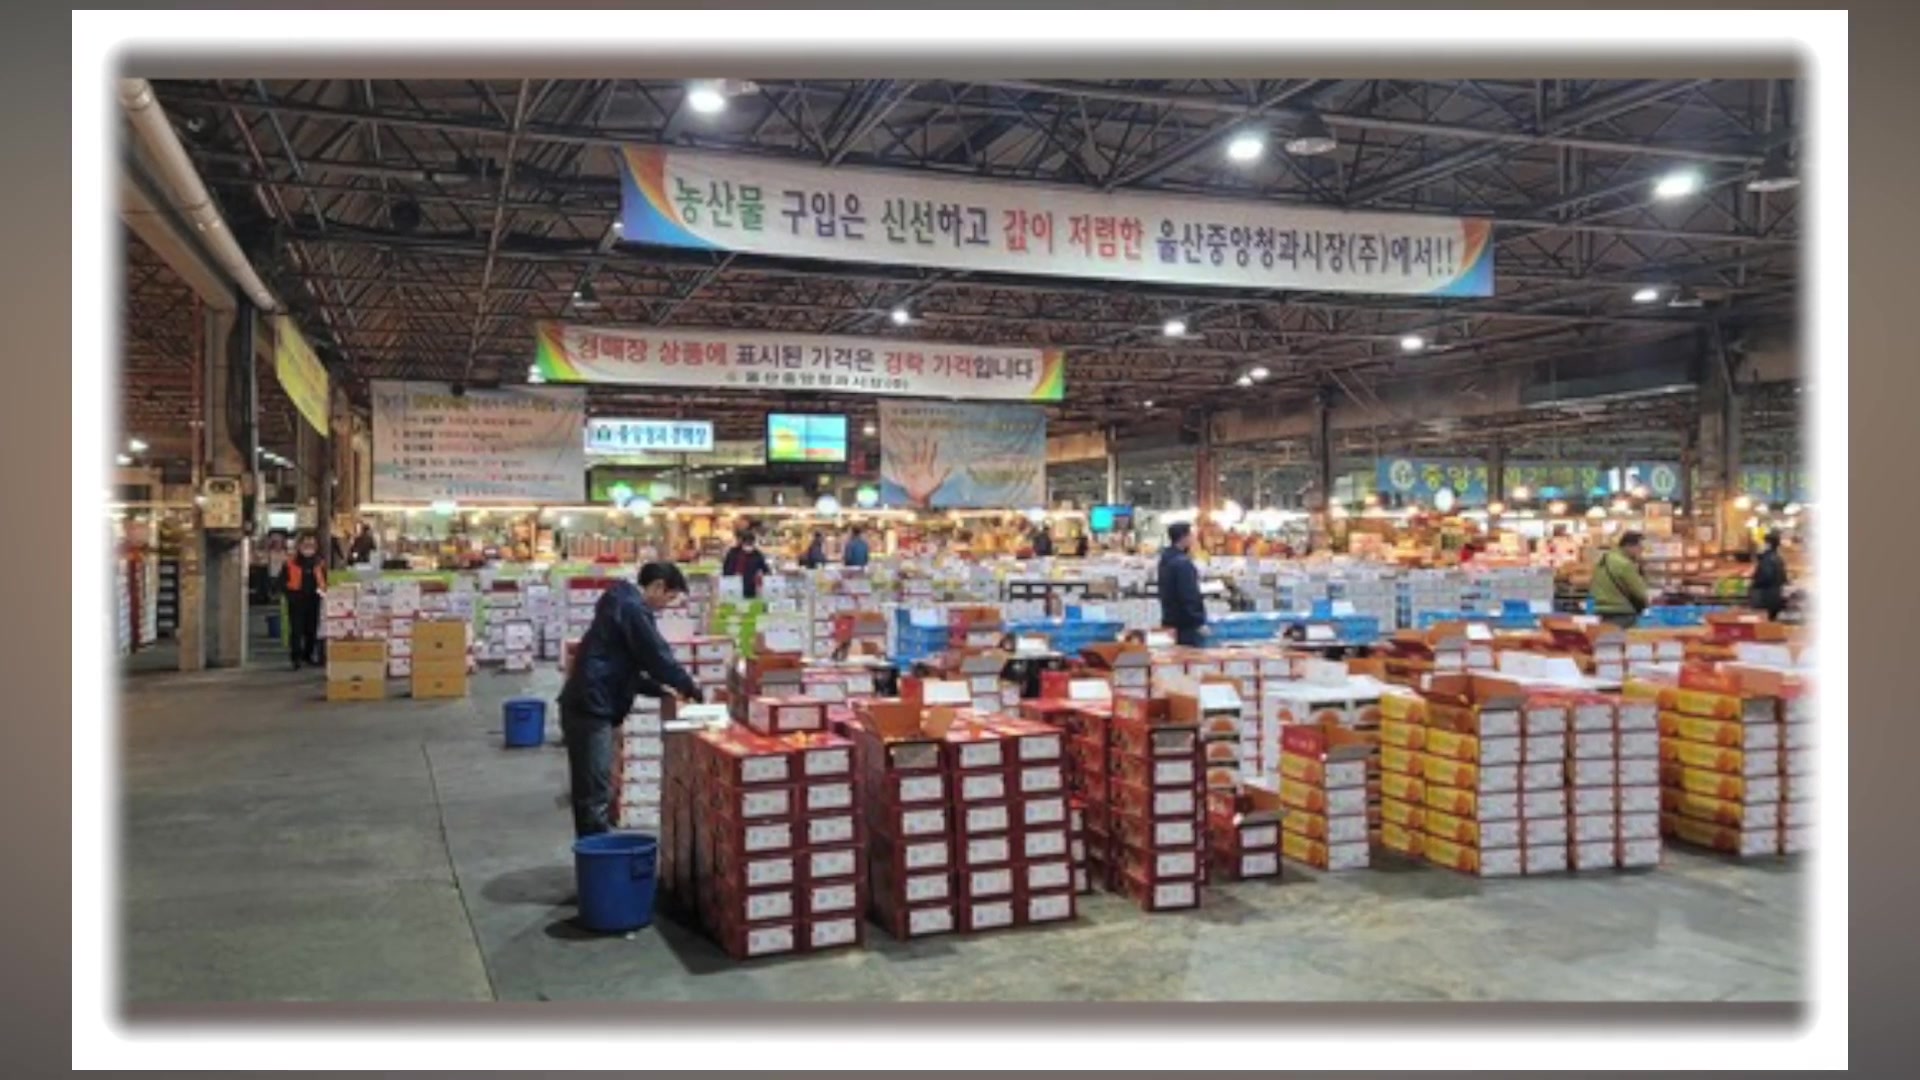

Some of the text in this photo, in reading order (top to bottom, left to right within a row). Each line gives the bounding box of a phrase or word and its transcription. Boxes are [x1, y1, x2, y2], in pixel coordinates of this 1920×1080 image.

[675, 177, 765, 231] 농산물
[781, 190, 866, 239] 구입은
[881, 199, 991, 249] 신선하고
[1002, 207, 1054, 254] 값이
[1068, 214, 1145, 261] 저렴한
[659, 341, 728, 366] 상품에
[736, 344, 803, 368] 표시된
[811, 346, 875, 372] 가격은
[932, 354, 1034, 379] 가격입니다
